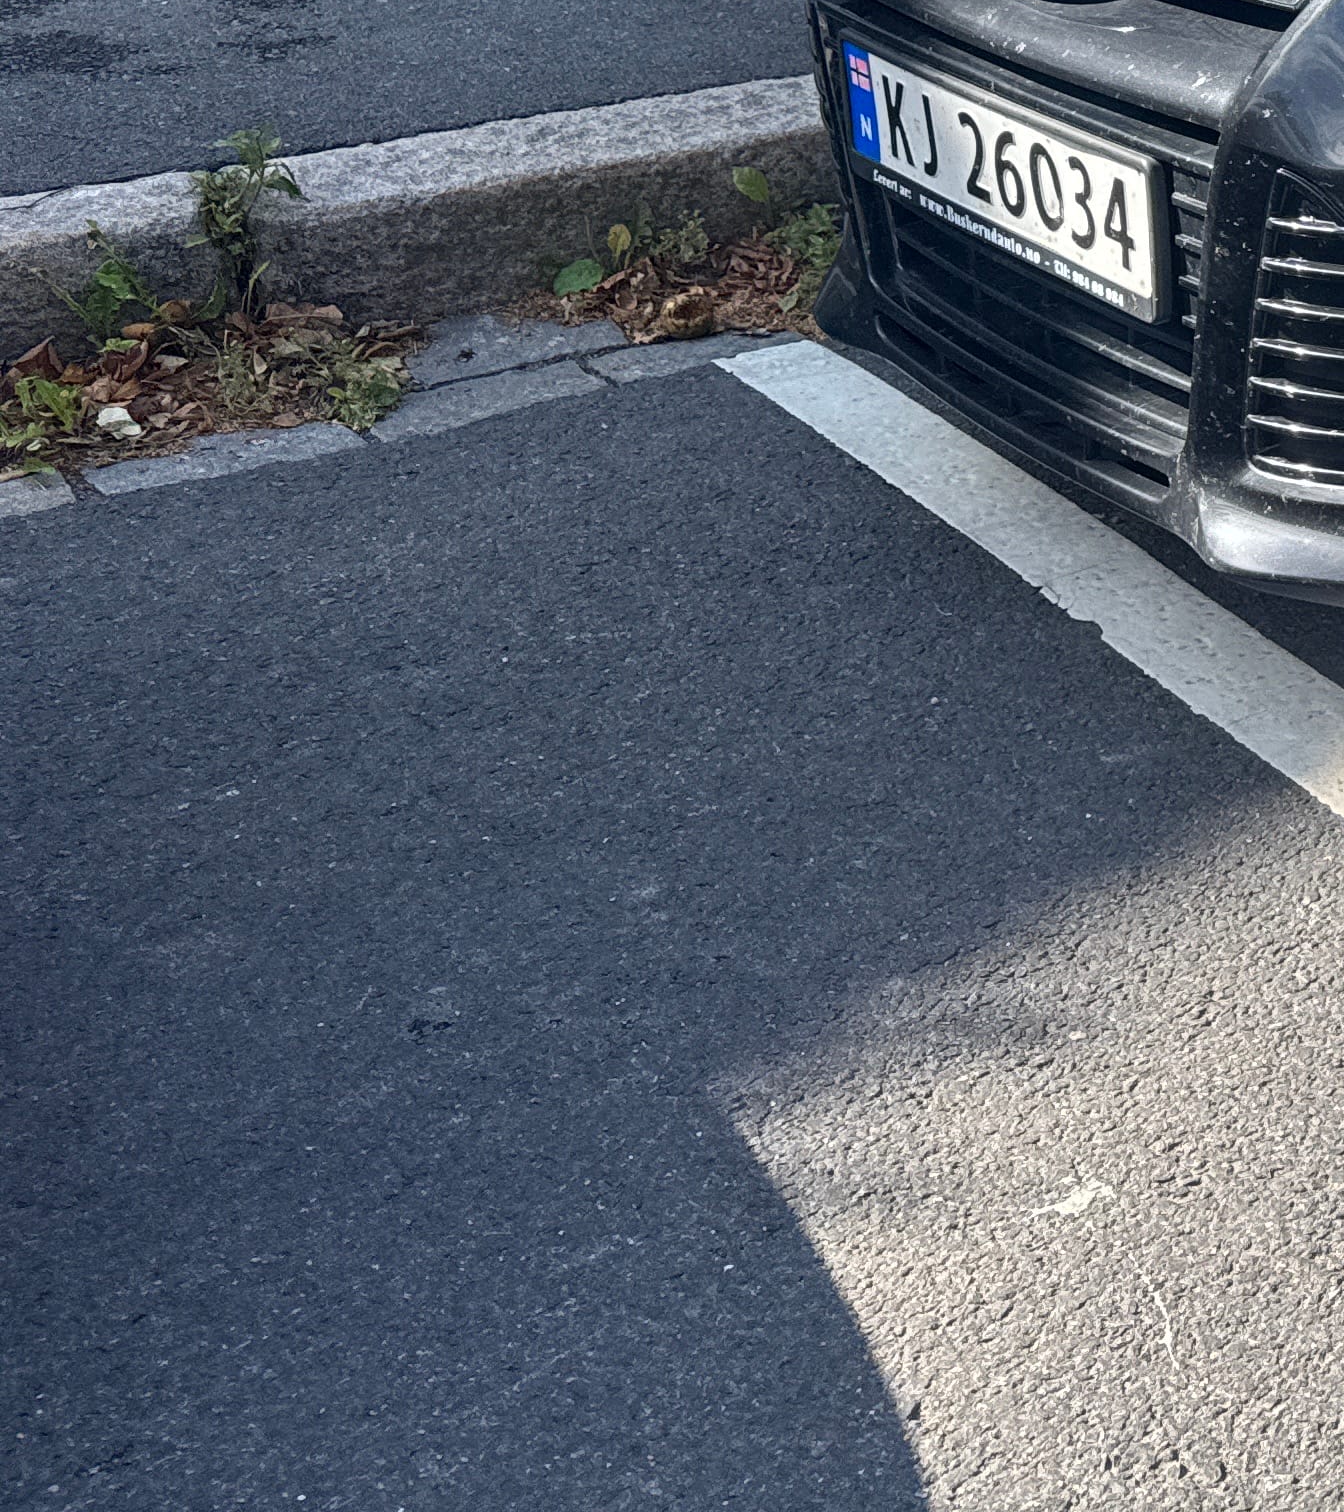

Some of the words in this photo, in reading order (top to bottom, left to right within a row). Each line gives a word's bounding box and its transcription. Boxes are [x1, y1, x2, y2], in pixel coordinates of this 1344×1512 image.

[859, 113, 874, 142] N
[881, 74, 938, 178] KJ
[958, 111, 1137, 273] 26034
